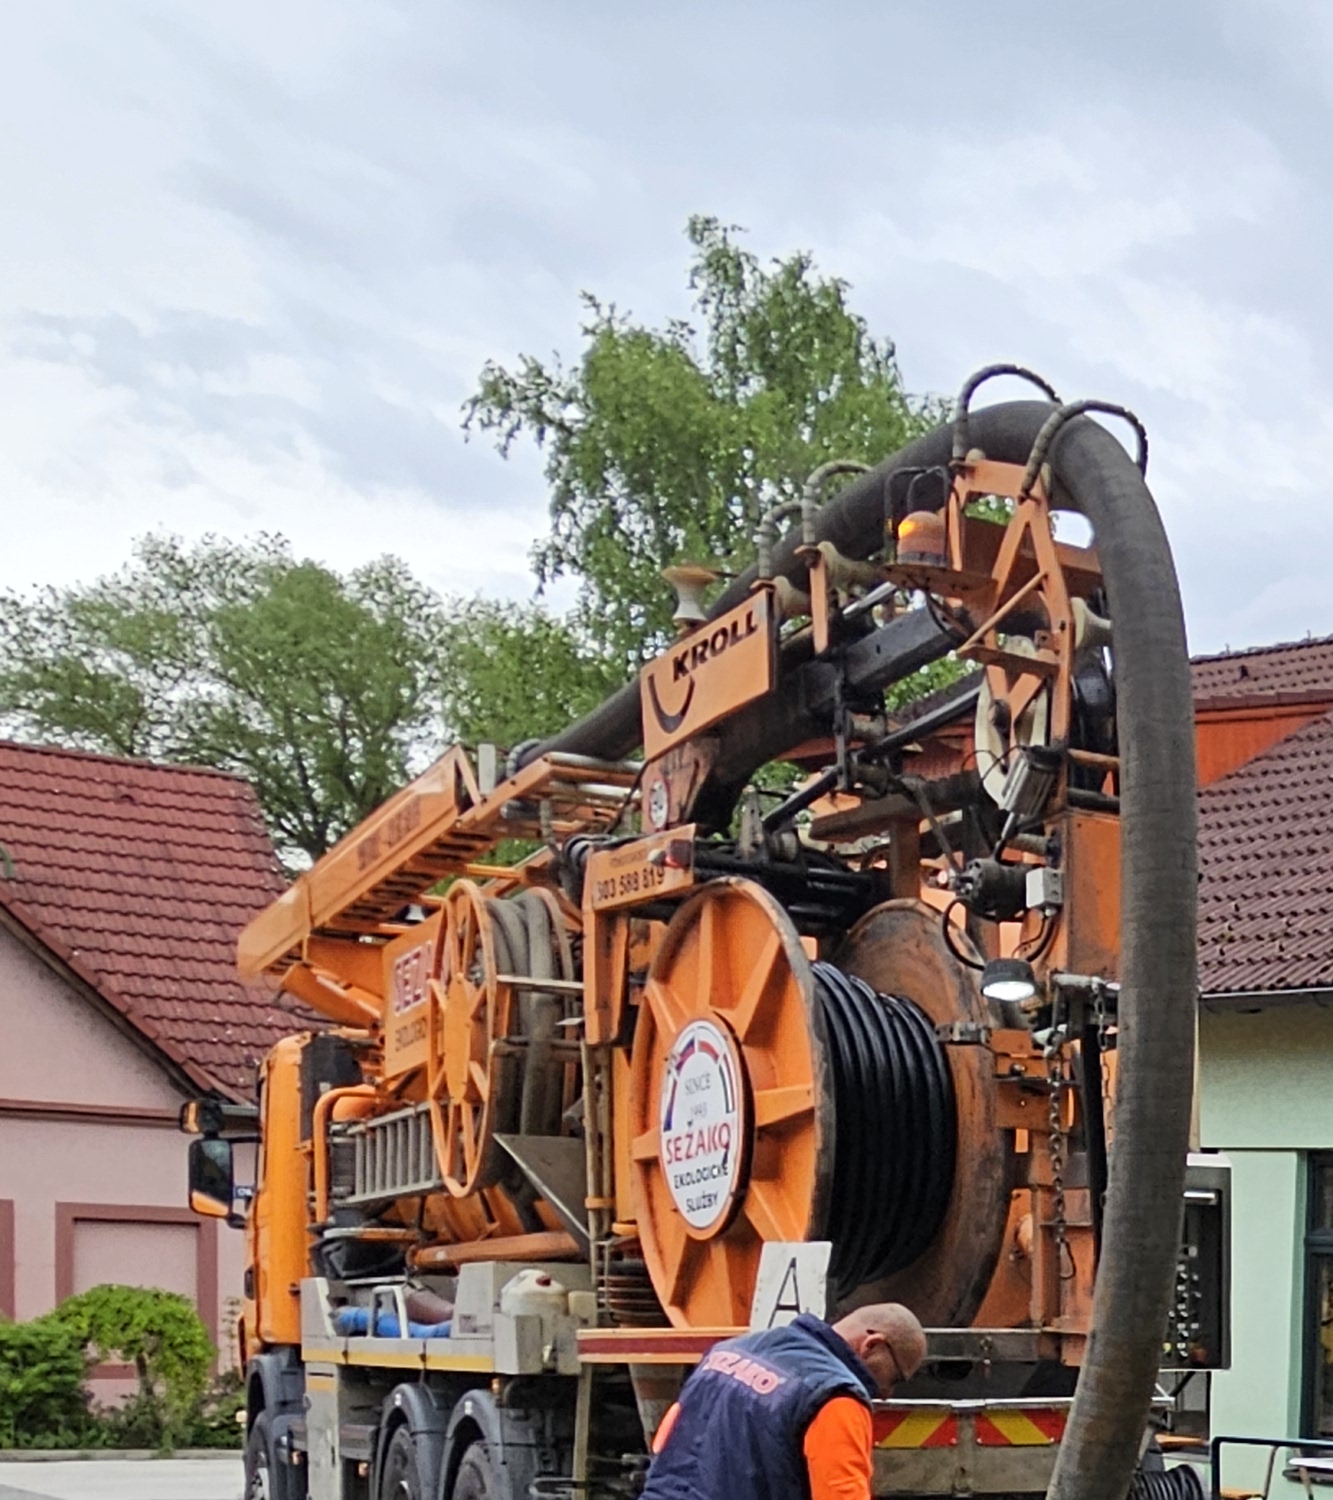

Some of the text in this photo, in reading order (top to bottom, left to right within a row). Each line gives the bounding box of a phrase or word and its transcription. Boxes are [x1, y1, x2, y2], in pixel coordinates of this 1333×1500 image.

[671, 609, 759, 683] KROLL
[684, 1072, 712, 1097] SINCE
[767, 1256, 802, 1330] A
